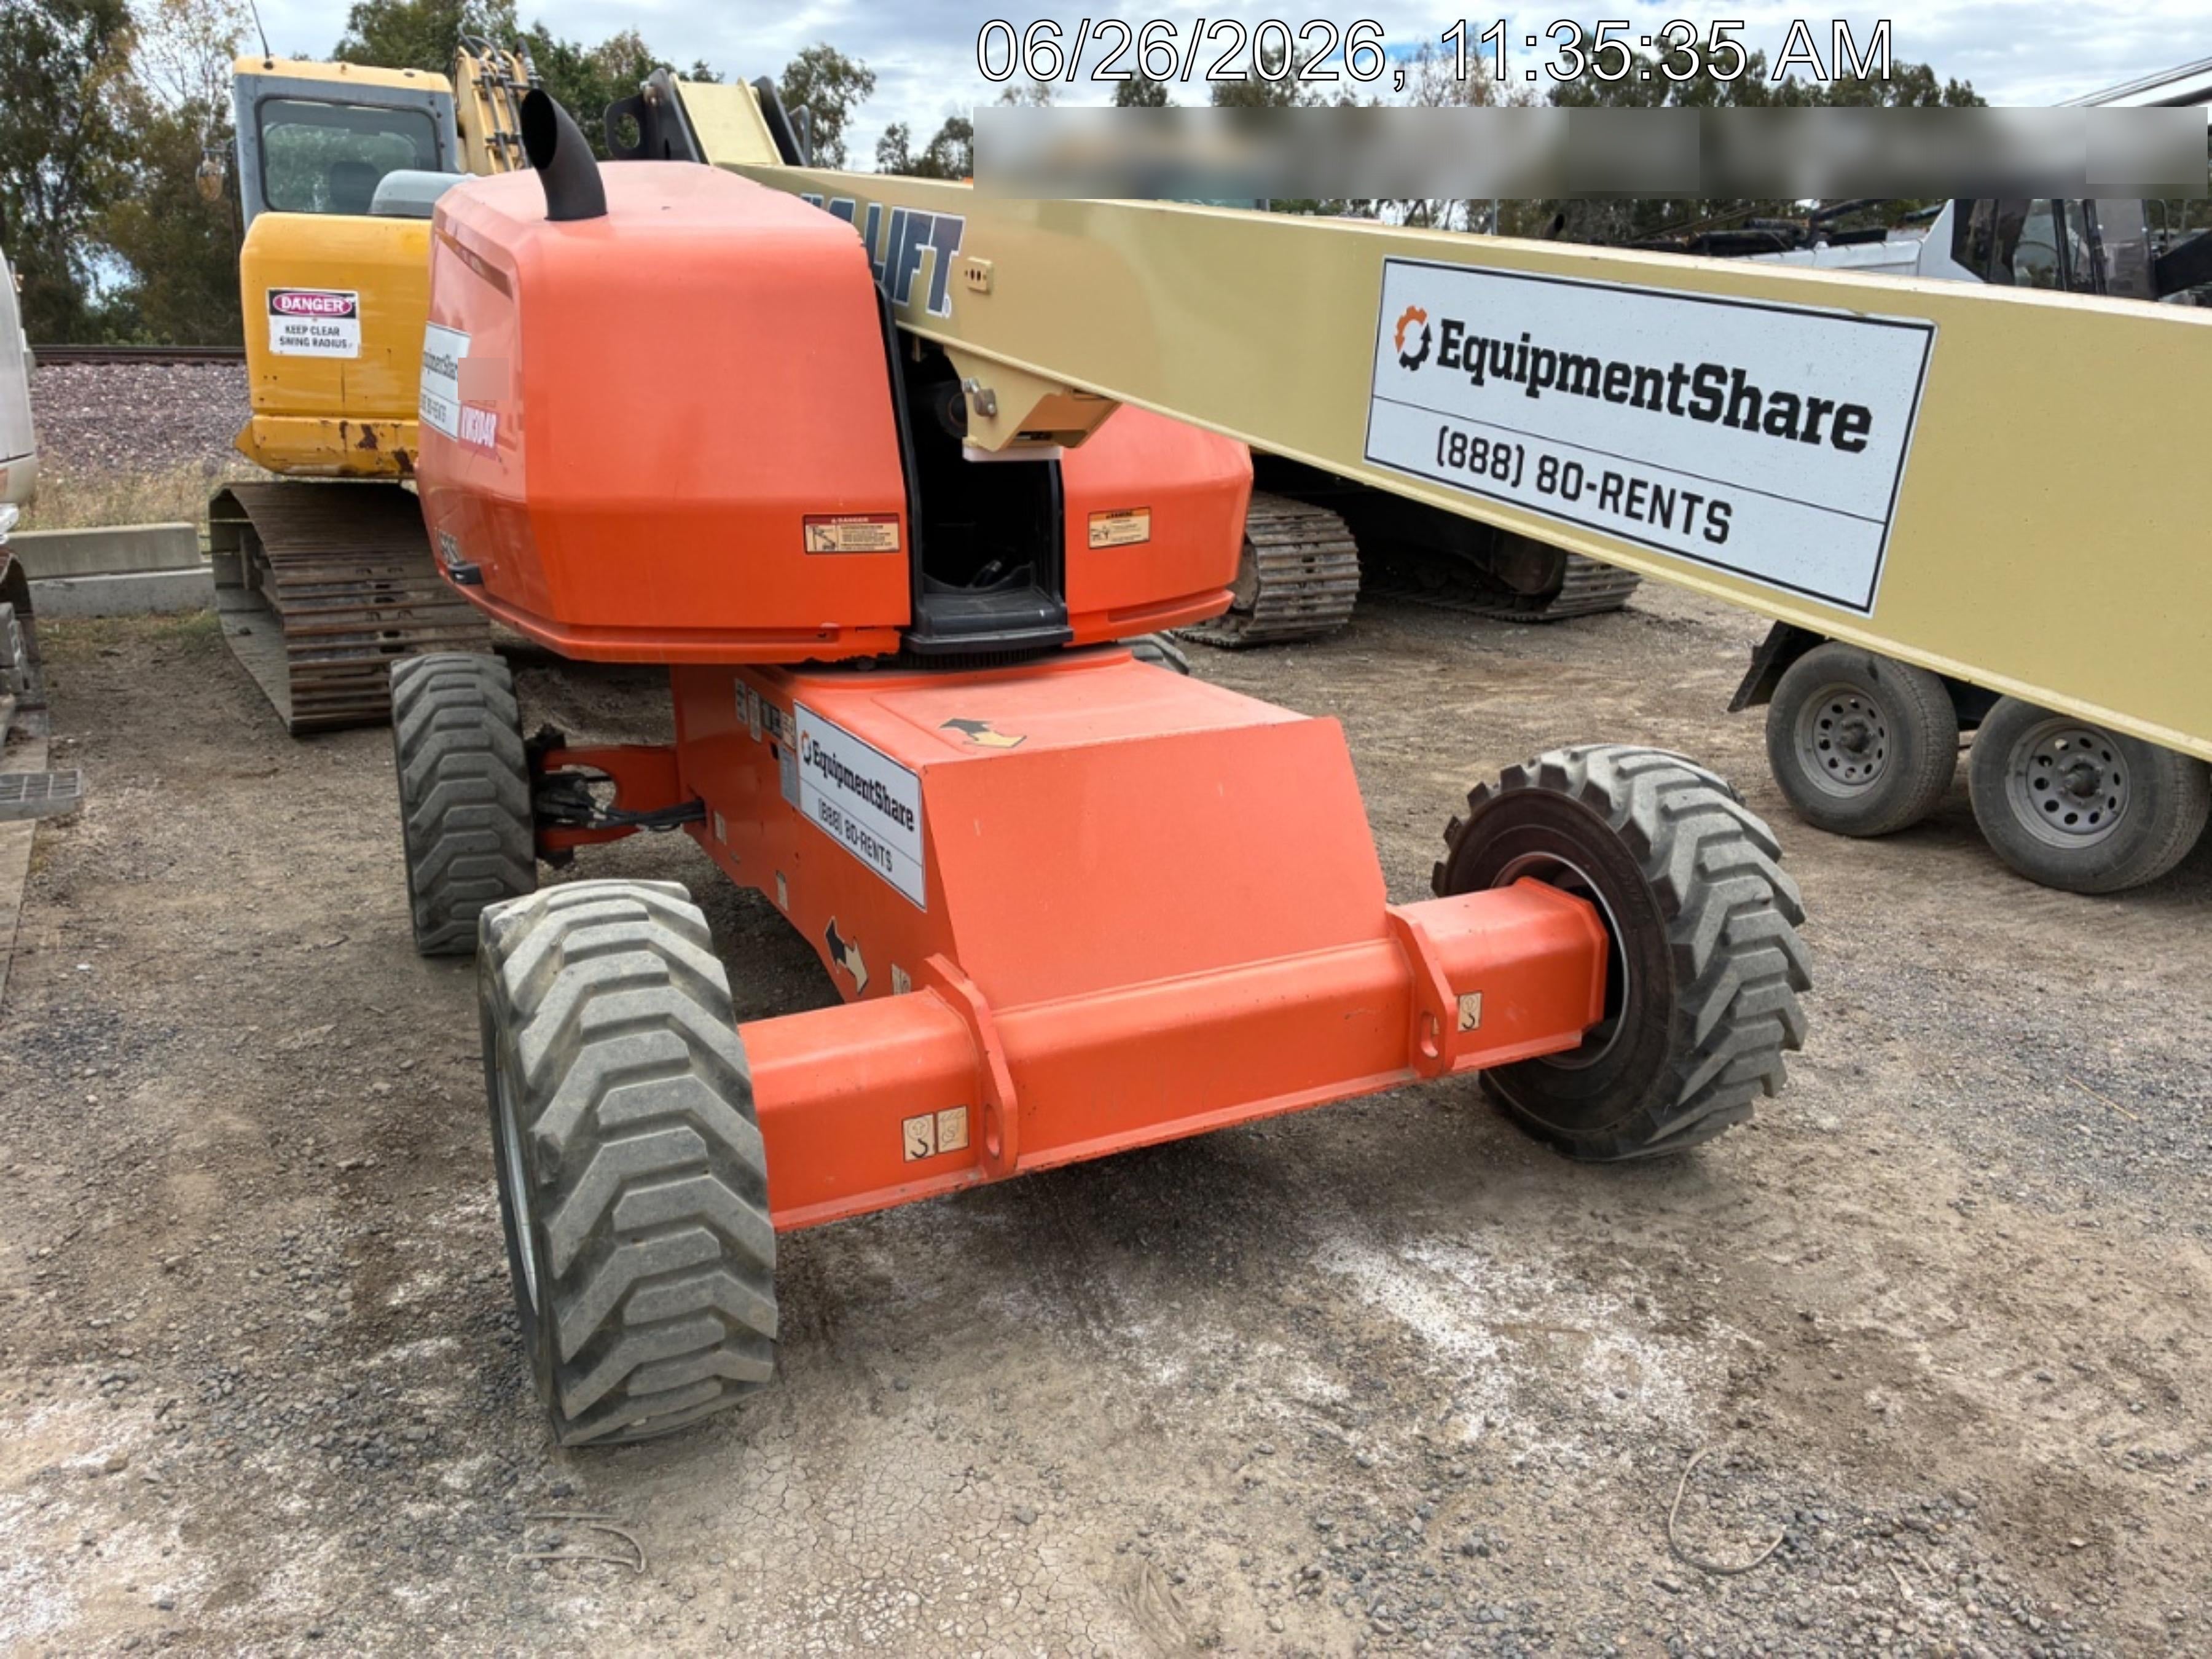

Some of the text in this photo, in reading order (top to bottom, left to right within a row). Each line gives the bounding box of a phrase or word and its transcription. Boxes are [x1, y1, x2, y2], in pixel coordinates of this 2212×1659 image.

[280, 336, 347, 349] SWING RADIUS
[281, 296, 343, 313] DANGER
[285, 325, 340, 336] KEEP CLEAR
[1437, 318, 1873, 453] EquipmentShare
[1436, 425, 1734, 545] (888) 80-RENTS
[812, 740, 915, 832] EquipmentShare
[818, 797, 893, 873] (888) 80-RENTS
